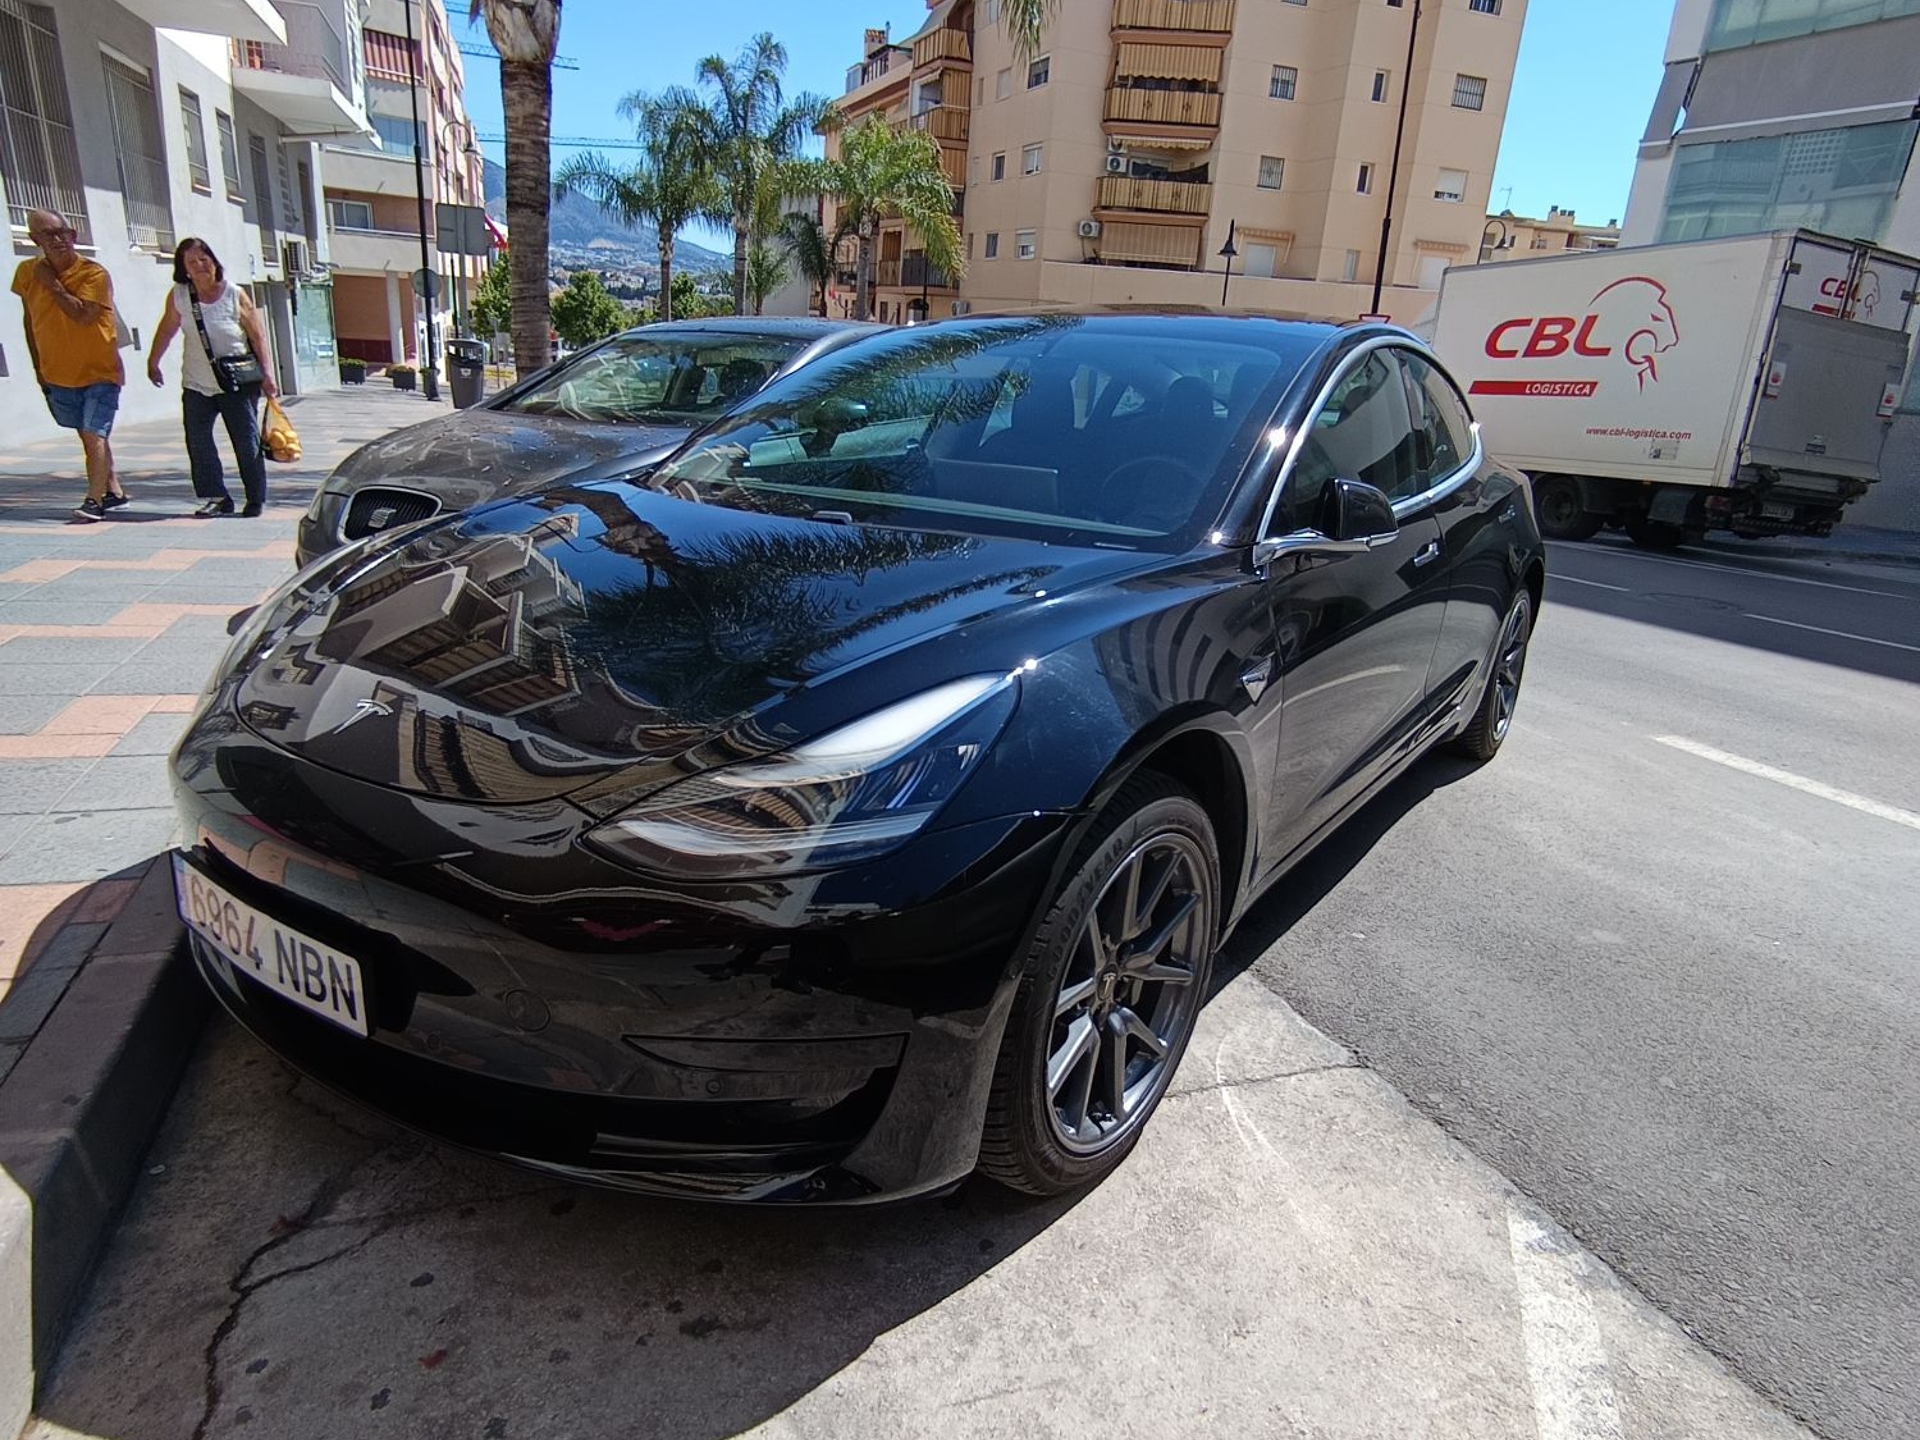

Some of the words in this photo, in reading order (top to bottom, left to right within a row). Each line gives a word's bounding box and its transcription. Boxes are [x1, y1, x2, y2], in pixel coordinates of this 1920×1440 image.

[1484, 314, 1612, 358] CBL
[1525, 382, 1592, 396] LOGISTICA
[1586, 428, 1692, 440] www.cbl-logistica.com
[1048, 837, 1124, 982] GOODYEAR
[191, 875, 263, 971] 6964
[274, 928, 358, 1022] NBN
